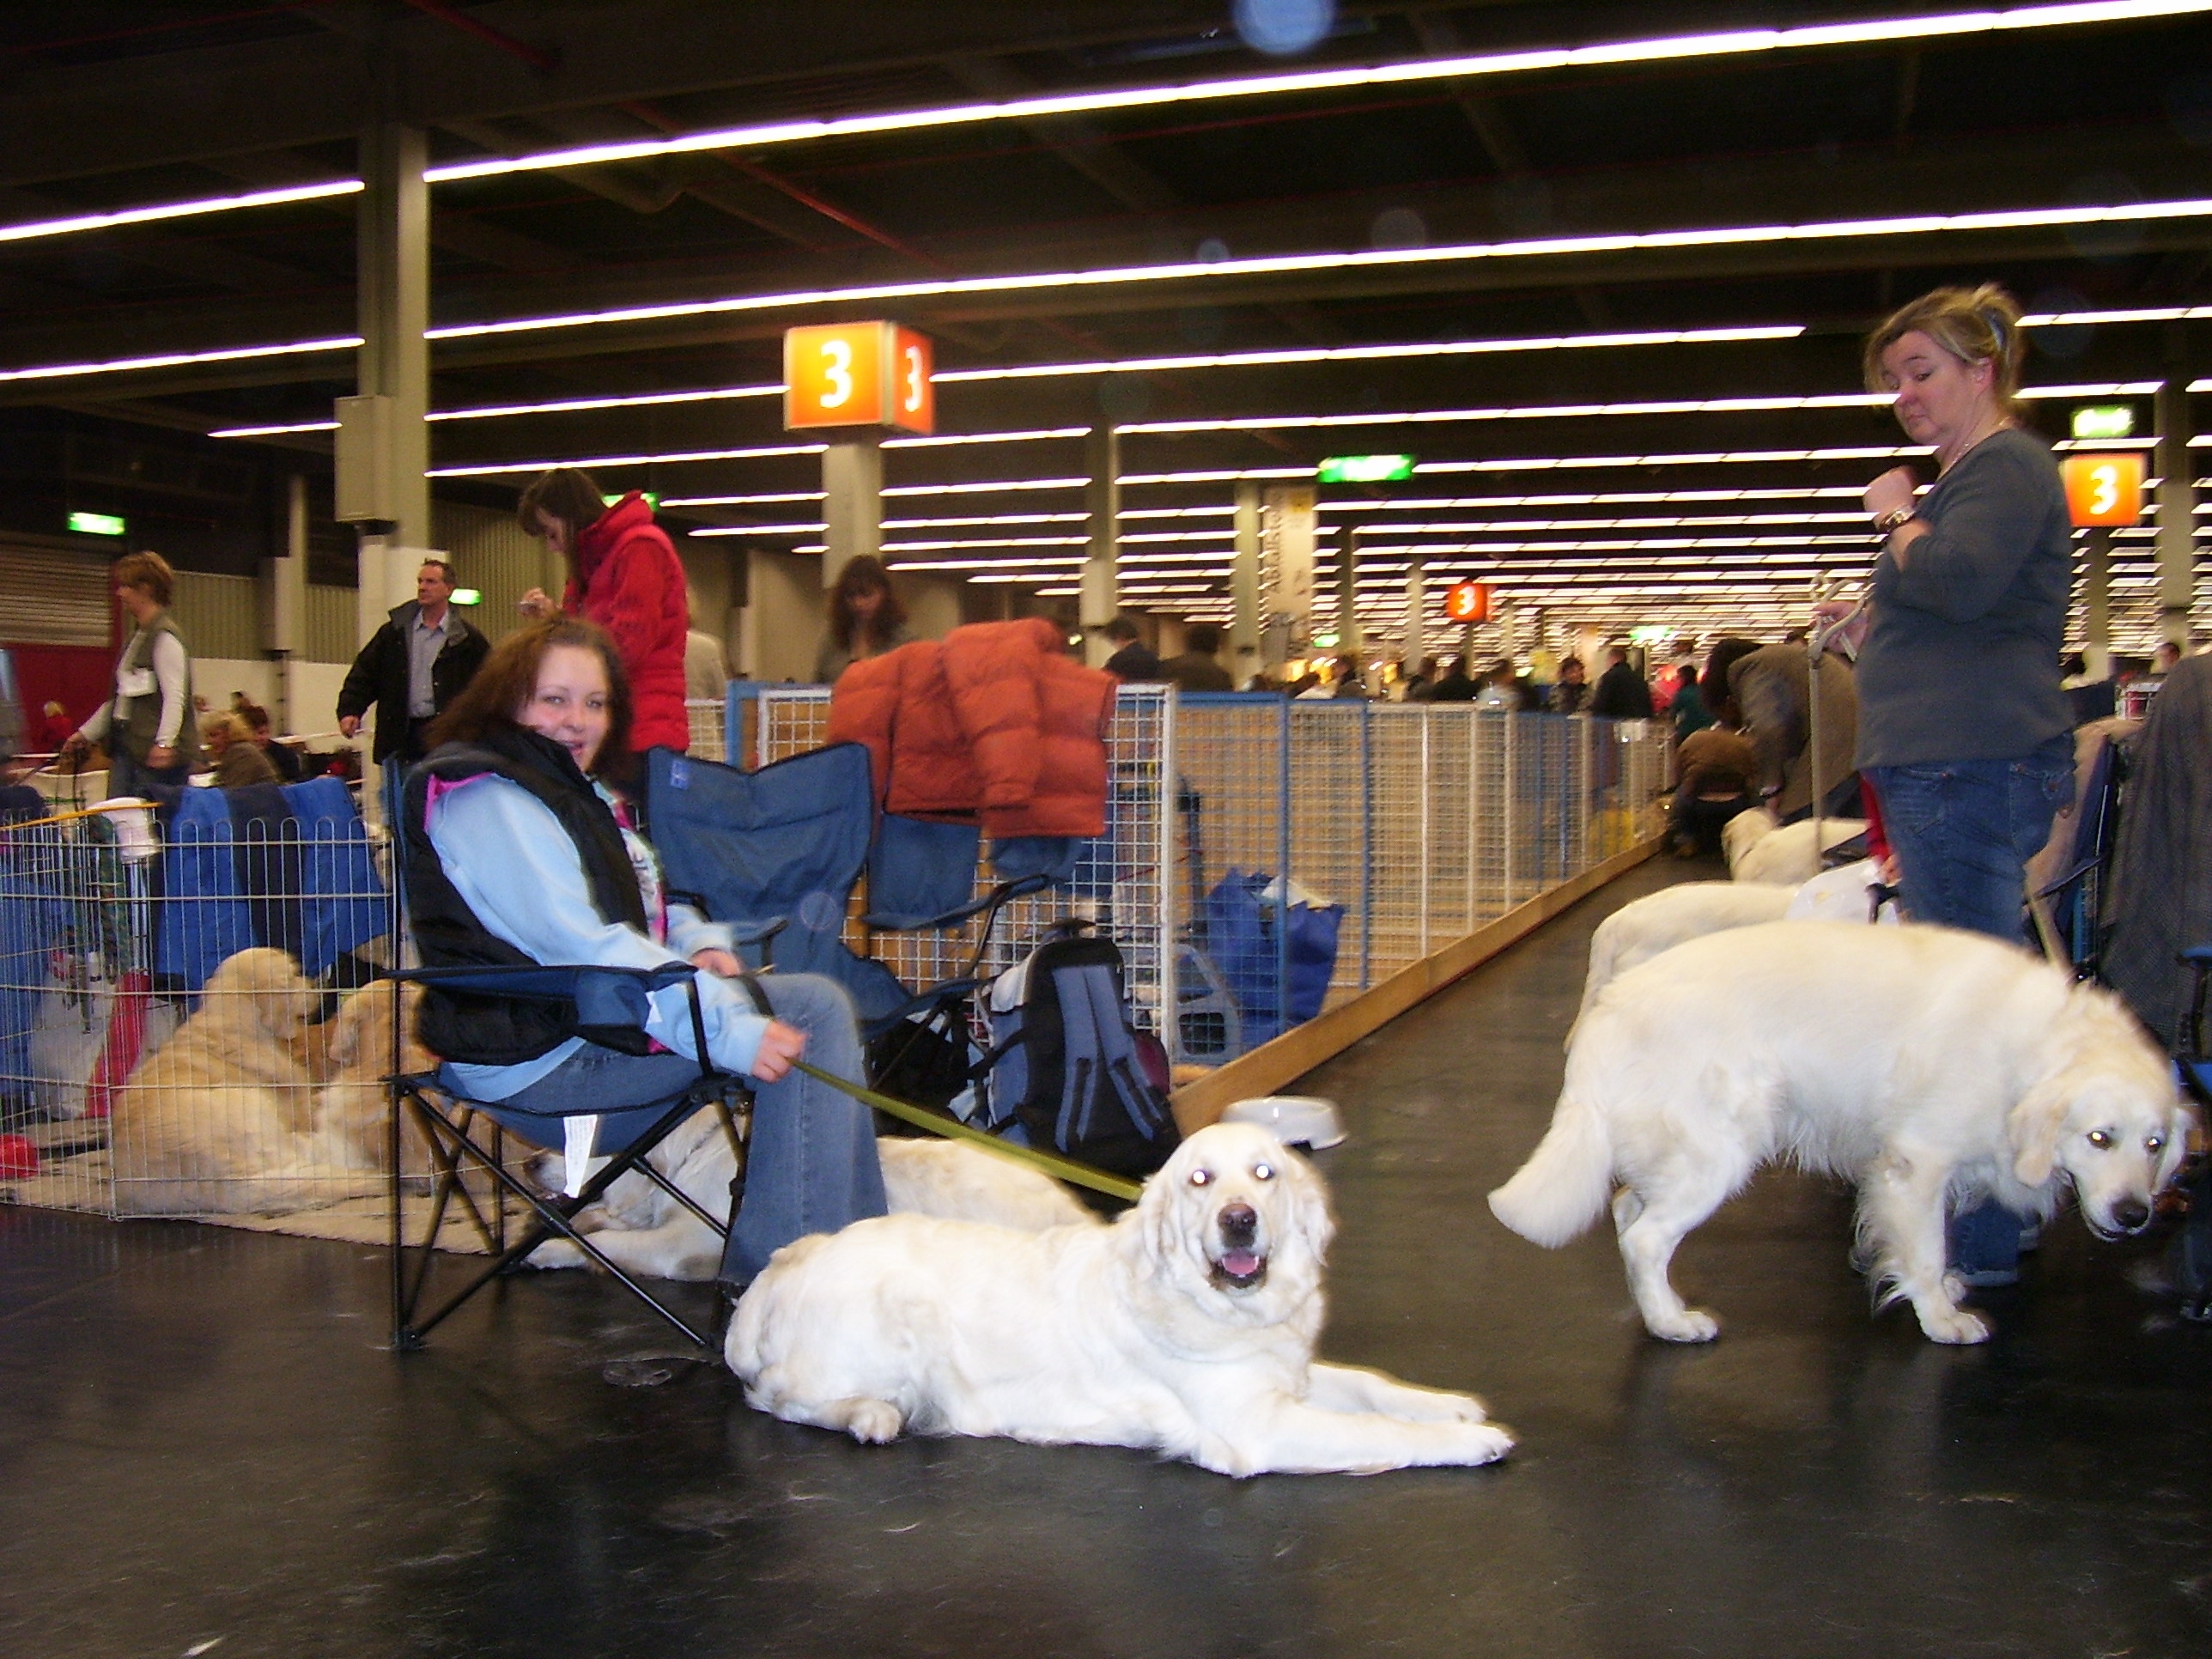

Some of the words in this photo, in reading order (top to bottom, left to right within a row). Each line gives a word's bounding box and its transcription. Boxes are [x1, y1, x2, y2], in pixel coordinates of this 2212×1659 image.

[820, 339, 853, 408] 3
[905, 345, 923, 412] 3
[2089, 465, 2118, 514] 3
[1457, 586, 1475, 615] 3
